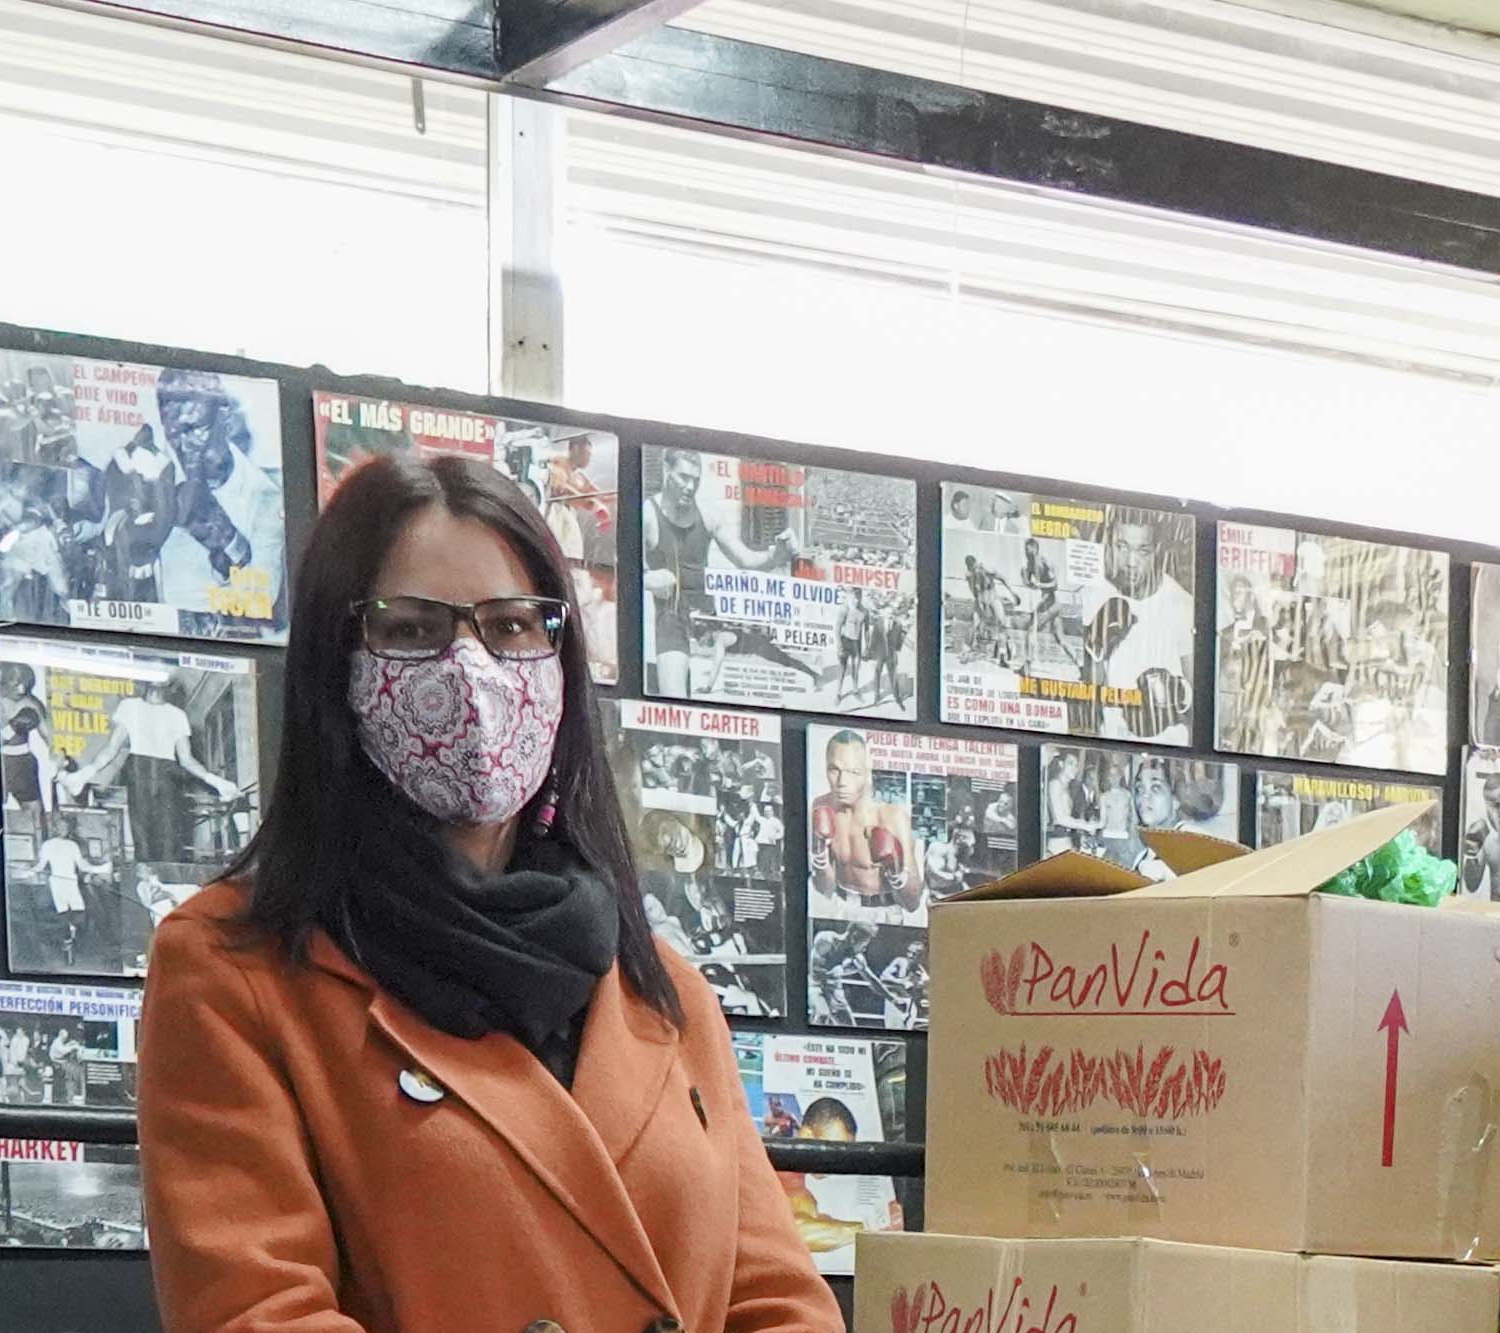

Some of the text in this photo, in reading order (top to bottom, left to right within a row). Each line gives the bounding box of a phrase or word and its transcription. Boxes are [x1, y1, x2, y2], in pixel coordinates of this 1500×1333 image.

[105, 387, 139, 407] VINO
[73, 407, 92, 423] DE
[319, 400, 494, 443] «EL MÁS GRANDE»
[1219, 523, 1254, 546] EMILE
[834, 565, 900, 588] DEMPSEY
[720, 597, 736, 613] DE
[964, 700, 1062, 718] COMO BOMBA
[52, 709, 110, 734] WILLIE
[637, 705, 760, 738] JIMMY CARTER
[53, 732, 87, 756] PEP
[866, 731, 960, 752] PUEDE TENGA
[1023, 929, 1229, 1010] PanVida
